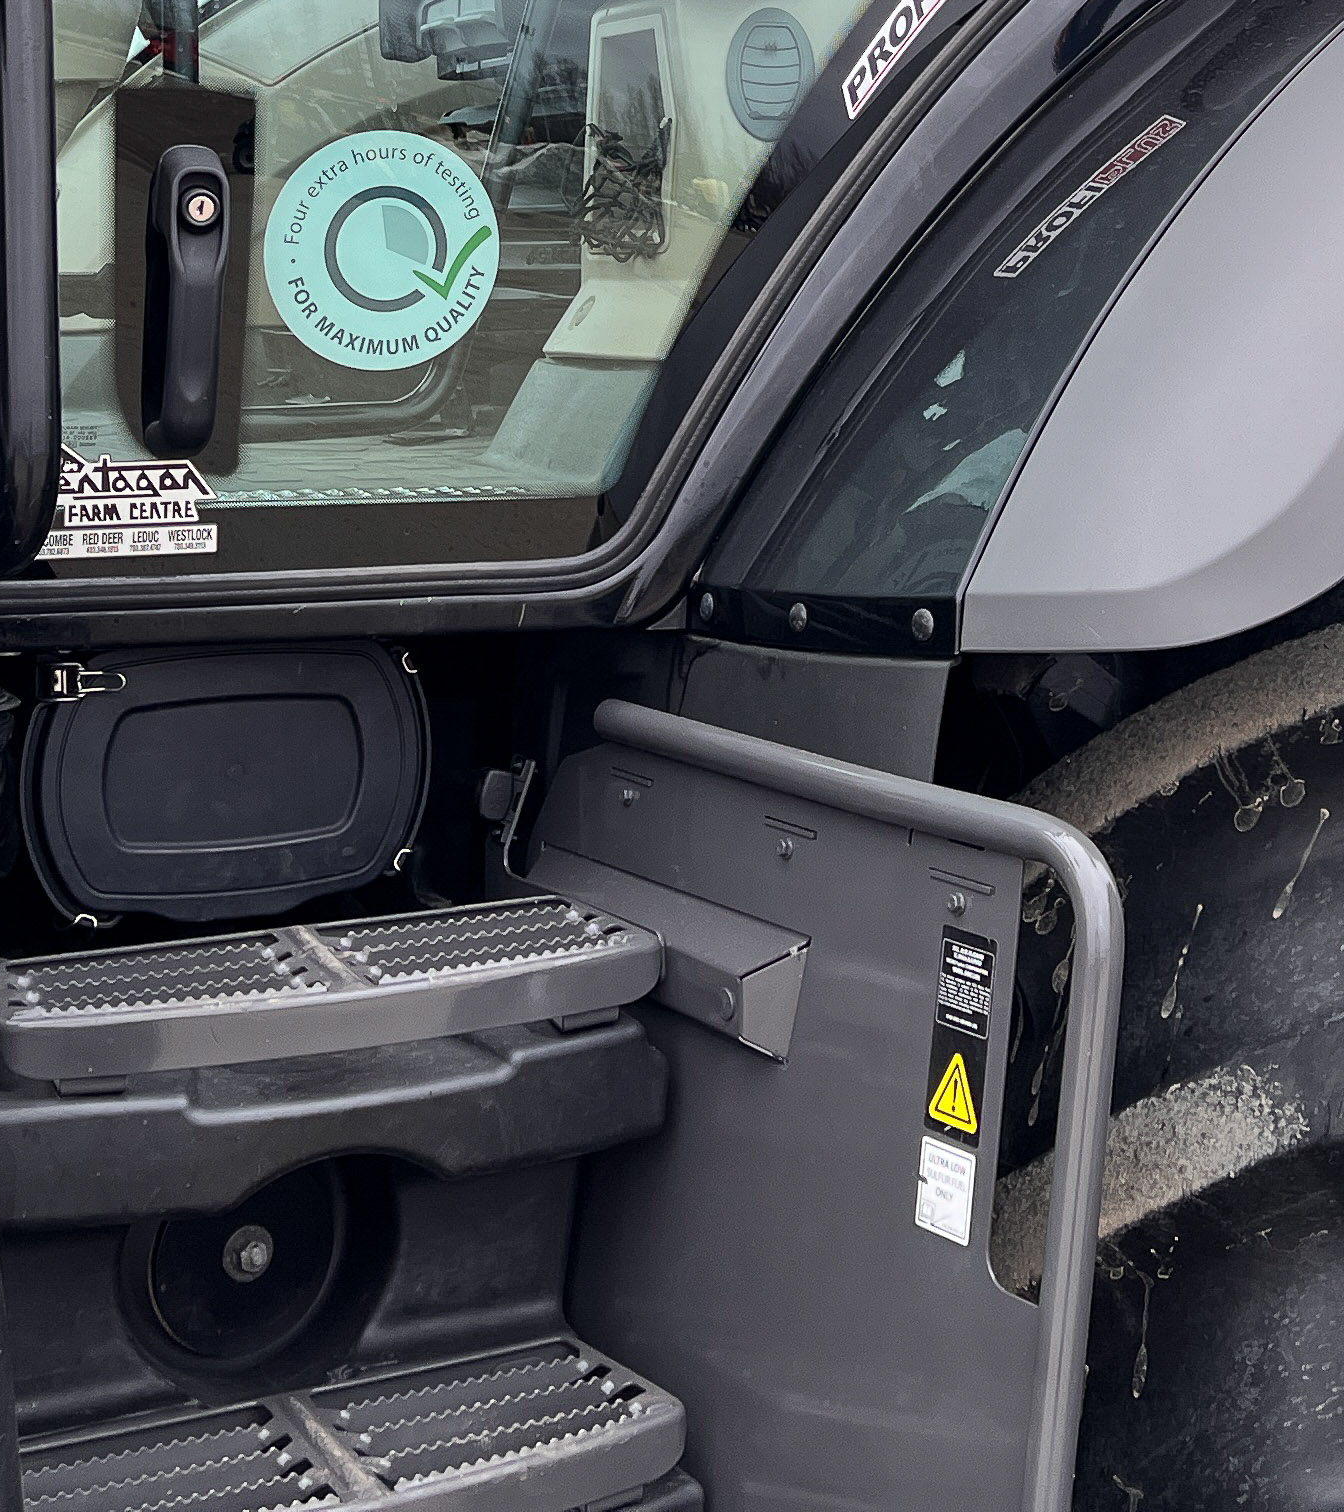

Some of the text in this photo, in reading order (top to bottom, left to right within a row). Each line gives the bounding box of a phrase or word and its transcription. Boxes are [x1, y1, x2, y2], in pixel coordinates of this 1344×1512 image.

[284, 147, 481, 245] Four extra hours of testing
[288, 265, 485, 356] FOR MAXIMUM QUALITY
[68, 500, 194, 522] FARM CENTRE
[82, 533, 99, 545] RED
[102, 532, 124, 545] DEER
[132, 530, 160, 544] LEDUC
[168, 528, 213, 542] WESTLOCK
[928, 1153, 966, 1176] ULTRA LOW
[936, 1186, 953, 1201] ONLY
